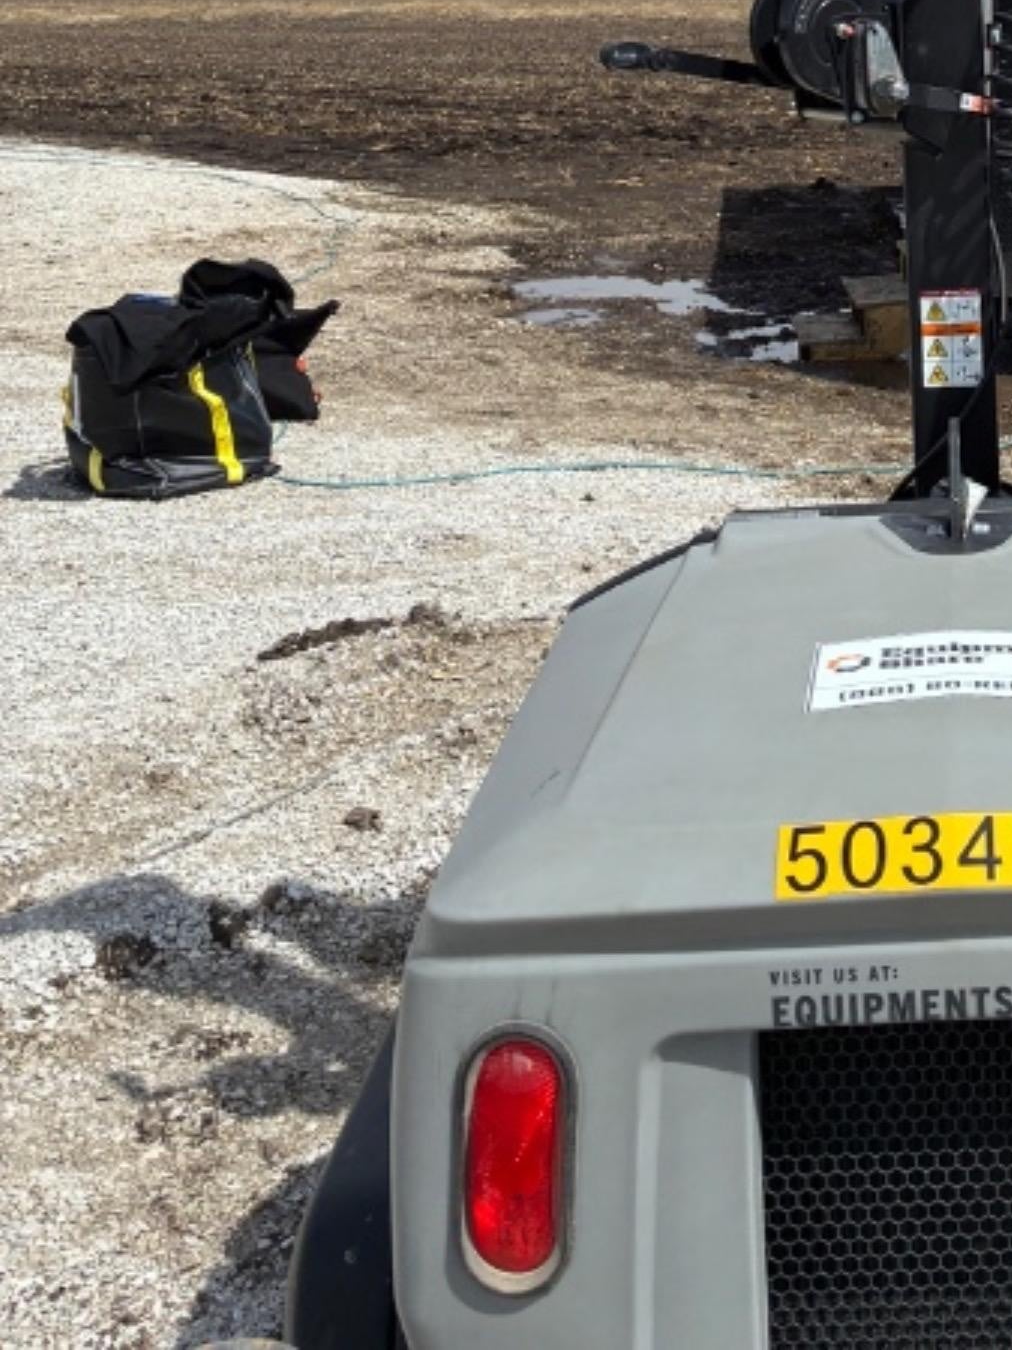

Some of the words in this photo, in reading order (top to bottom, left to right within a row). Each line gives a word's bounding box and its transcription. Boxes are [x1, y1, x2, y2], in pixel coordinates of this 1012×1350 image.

[769, 969, 823, 986] VISIT
[833, 967, 858, 983] US
[868, 965, 899, 982] AT:
